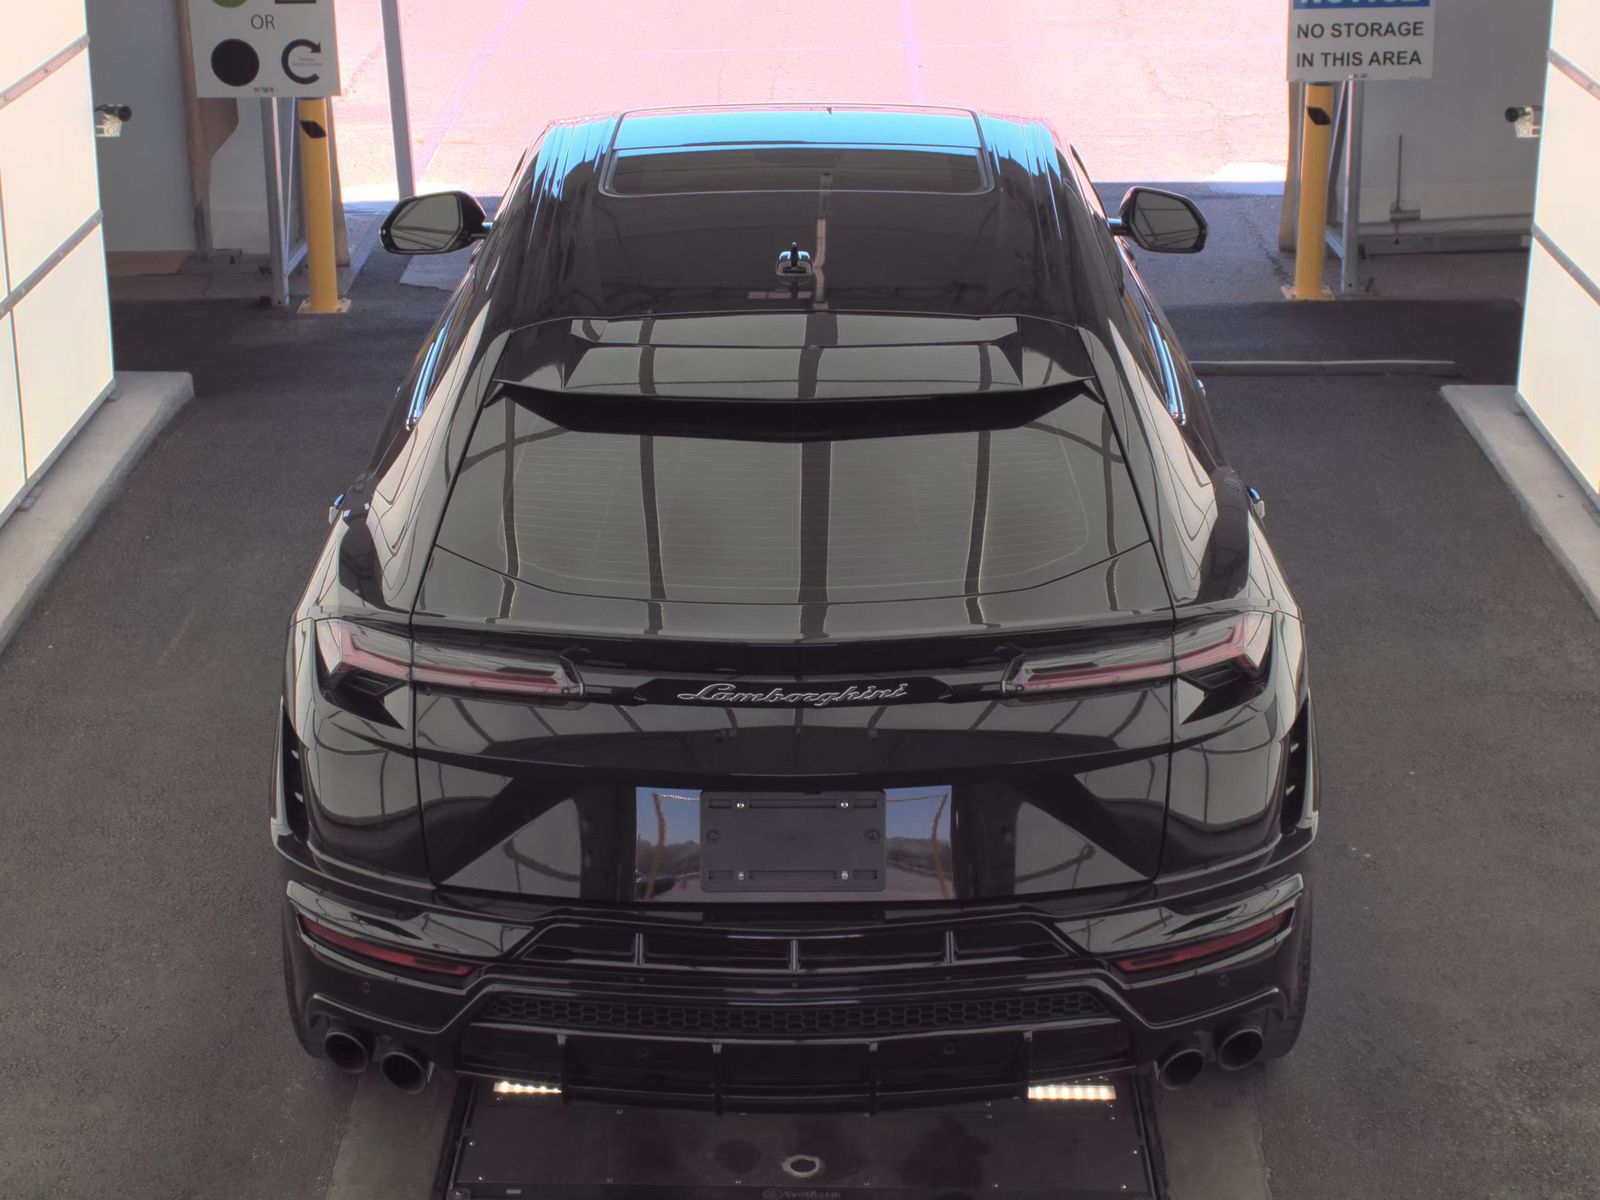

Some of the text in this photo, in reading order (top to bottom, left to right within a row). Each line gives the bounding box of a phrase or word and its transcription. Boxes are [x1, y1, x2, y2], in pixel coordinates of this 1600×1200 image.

[251, 14, 275, 30] OR
[1296, 21, 1424, 39] NO STORAGE
[1296, 50, 1422, 67] IN THIS AREA
[677, 682, 909, 707] Lamborghini
